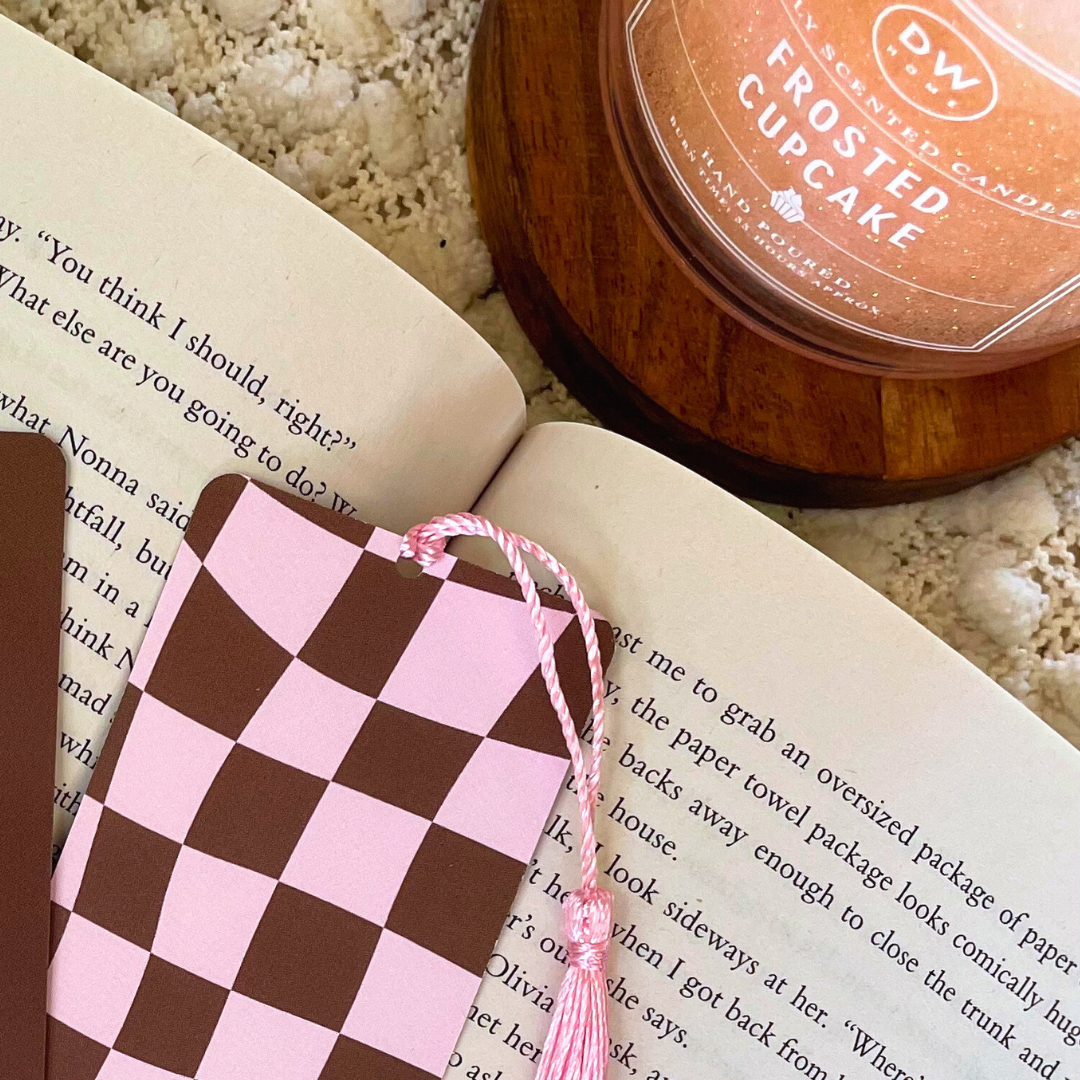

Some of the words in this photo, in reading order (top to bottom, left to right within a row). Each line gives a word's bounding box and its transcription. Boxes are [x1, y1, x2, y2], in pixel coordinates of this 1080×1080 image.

[767, 38, 948, 213] FROSTED
[821, 44, 940, 157] SCENTED
[899, 21, 981, 90] DW
[702, 150, 751, 213] HAND
[757, 221, 851, 289] POURED
[739, 73, 925, 249] CUPCAKE
[36, 229, 95, 285] “You
[97, 275, 167, 331] think
[166, 315, 188, 342] I
[184, 332, 270, 406] should,
[272, 396, 357, 453] right?”
[629, 696, 670, 732] the
[667, 727, 742, 780] paper
[742, 772, 812, 829] towel
[802, 822, 894, 892] package
[893, 880, 951, 937] looks
[951, 933, 1045, 1013] comically
[644, 649, 686, 682] me
[691, 676, 719, 704] to
[718, 701, 777, 744] grab
[780, 741, 811, 771] an
[816, 767, 920, 847] oversized
[910, 841, 996, 911] package
[998, 908, 1031, 933] of
[1016, 926, 1079, 976] paper
[601, 852, 660, 906] look
[661, 898, 760, 976] sideways
[762, 972, 789, 996] at
[788, 983, 829, 1029] her.
